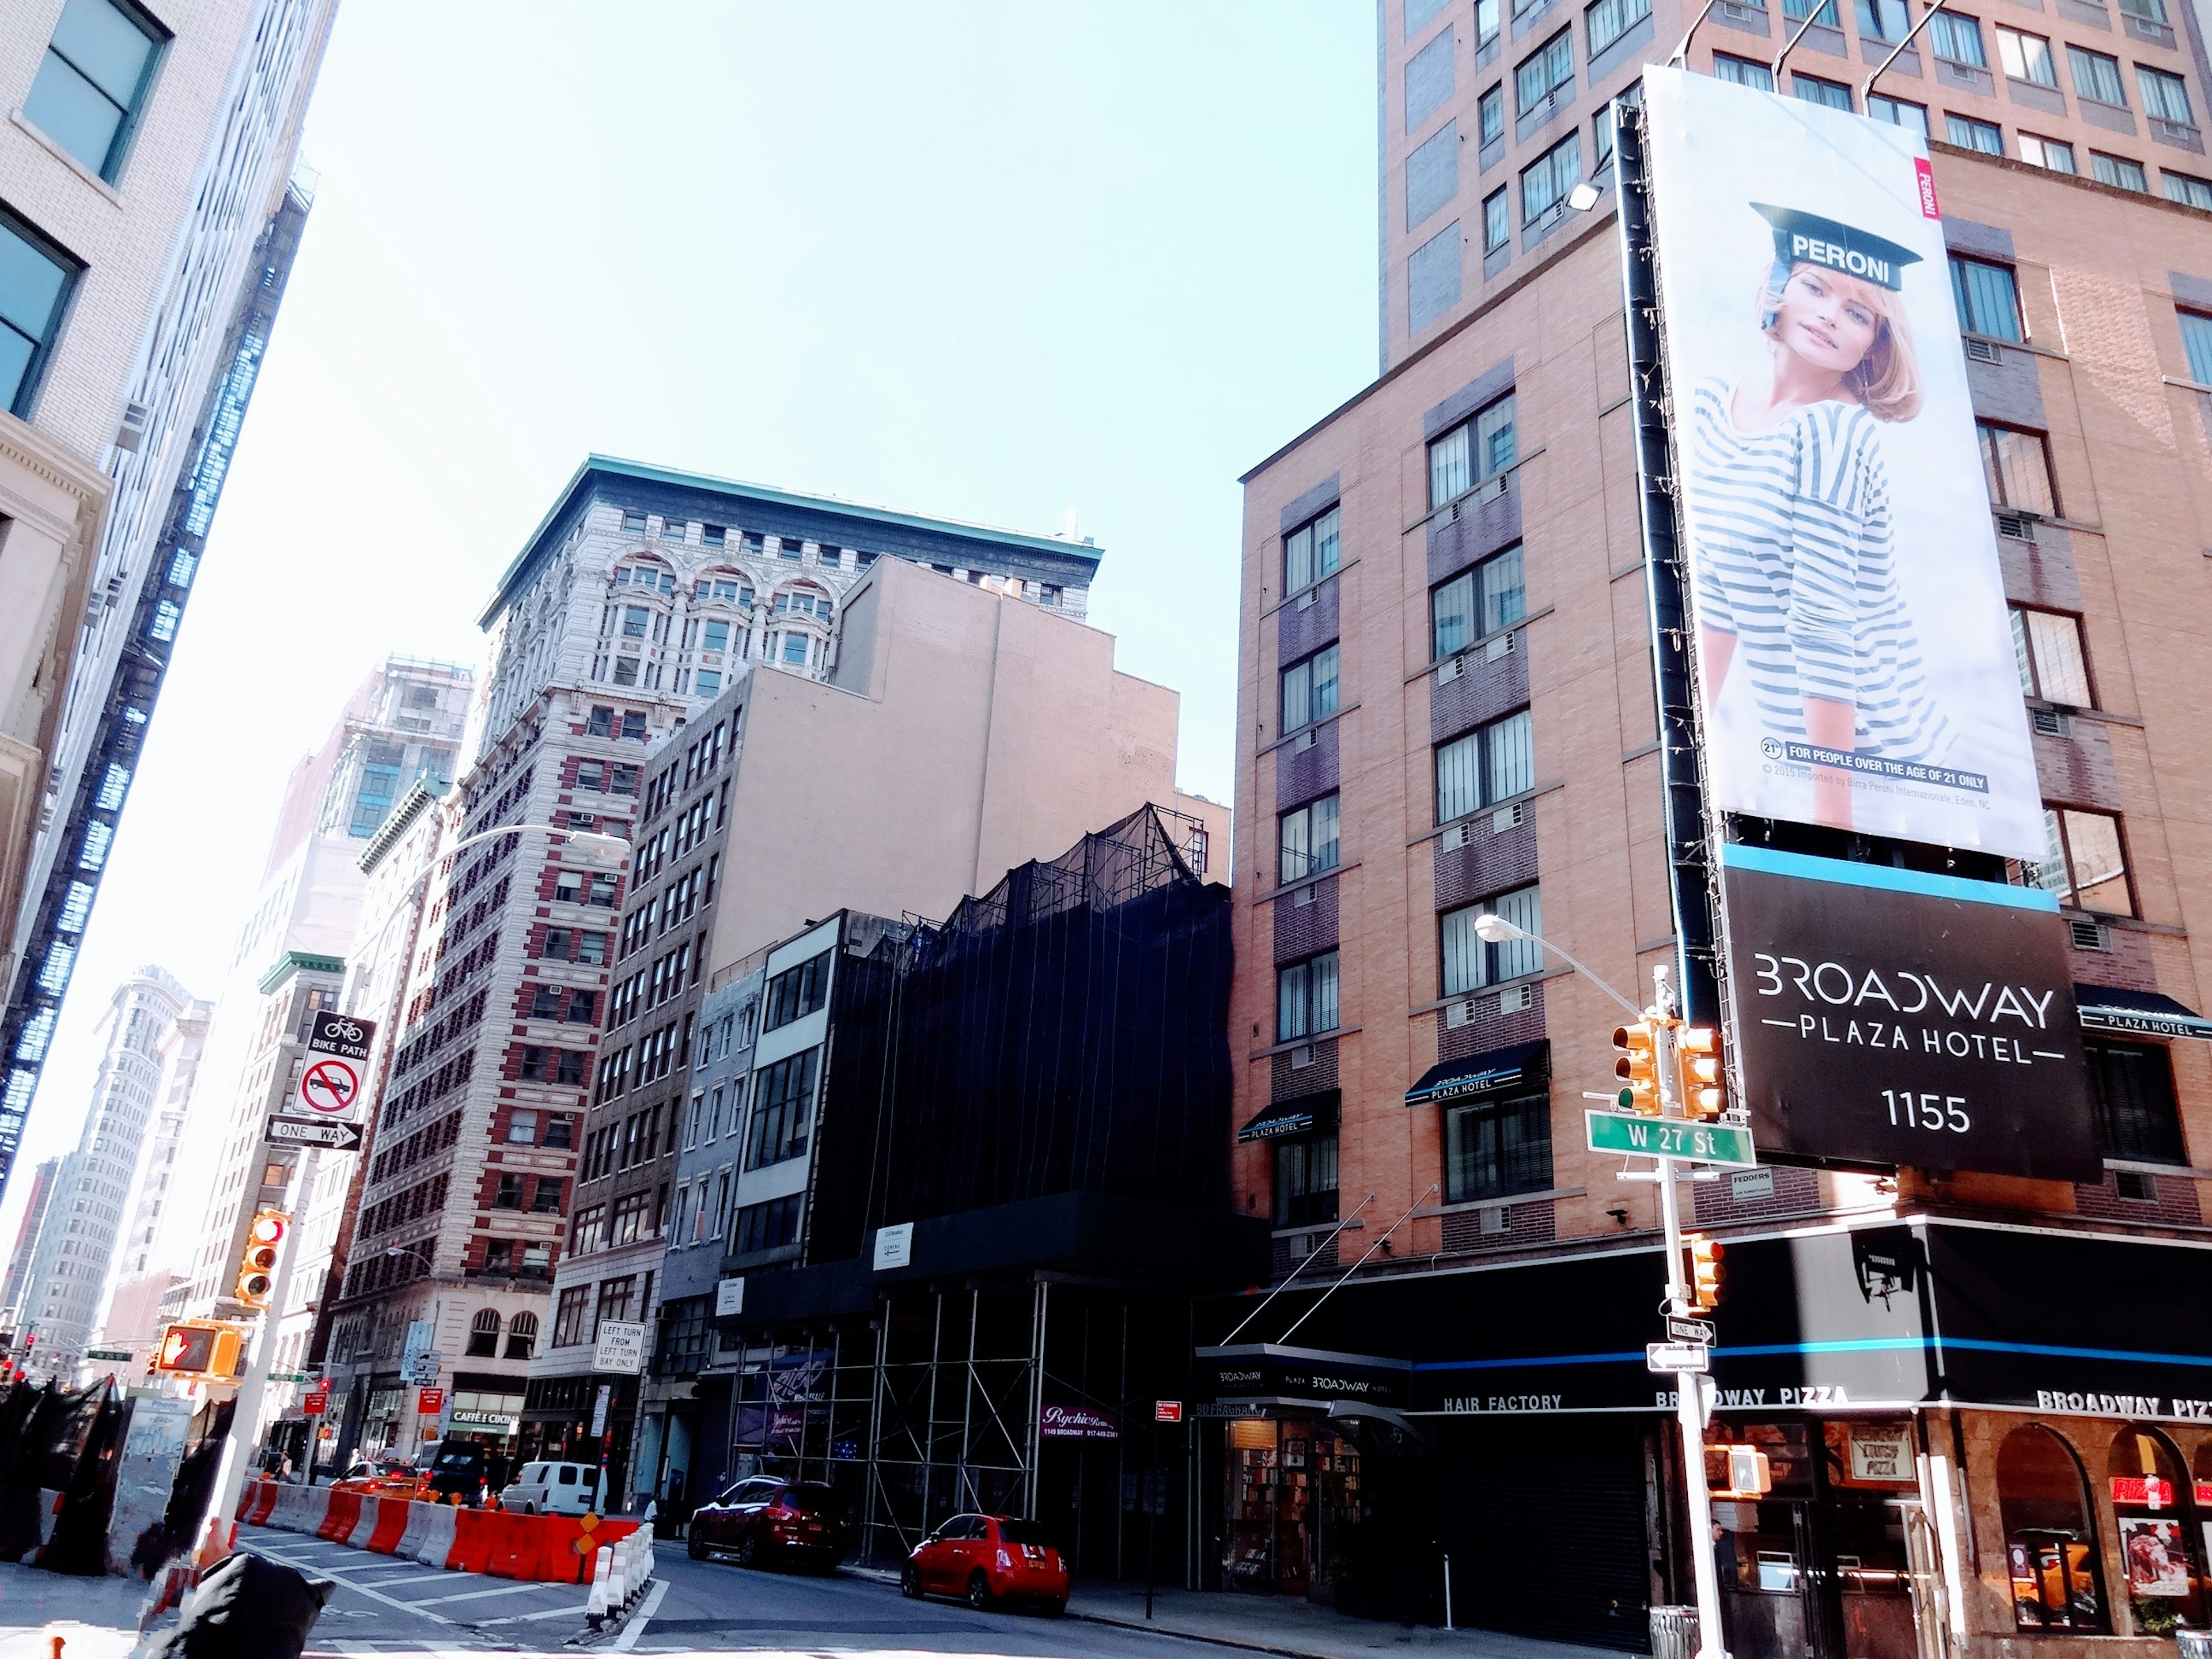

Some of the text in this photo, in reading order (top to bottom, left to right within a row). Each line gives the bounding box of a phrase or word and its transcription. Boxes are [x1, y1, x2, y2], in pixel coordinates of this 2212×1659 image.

[1919, 172, 1936, 215] PERONI
[1793, 234, 1889, 283] PERONI
[1789, 745, 1984, 789] FOR PEOPLE OVER THE AGE OF 21 ONLY
[1775, 766, 1795, 777] 2015
[1798, 770, 1834, 784] Imported
[1836, 775, 1845, 787] by
[1847, 777, 1867, 790] Birra
[1869, 781, 1893, 794] Peroni
[1956, 795, 1978, 808] Eden,
[1979, 799, 1991, 810] NC
[1755, 953, 2054, 1029] BROADWAY
[2108, 1016, 2194, 1035] PLAZA HOTEL
[312, 1038, 368, 1058] BIKE PATH
[1800, 1014, 2032, 1064] PLAZA HOTEL
[1431, 1080, 1491, 1099] PLAZA HOTEL
[1881, 1089, 1971, 1133] 1155
[280, 1124, 349, 1142] ONE WAY
[1251, 1123, 1297, 1138] PLAZA HOTEL
[1627, 1124, 1717, 1155] W 27 St
[1734, 1173, 1770, 1183] FEDDERS
[604, 1327, 641, 1337] LEFT TURN
[1675, 1324, 1709, 1339] ONE WAY
[611, 1337, 630, 1346] FROM
[600, 1347, 638, 1357] LEFT TURN
[600, 1357, 634, 1368] BAY ONLY
[1219, 1371, 1260, 1381] BROADWAY
[1286, 1376, 1305, 1384] PLAZA
[1312, 1377, 1369, 1392] BROADWAY
[151, 1400, 179, 1409] Phone
[1444, 1395, 1562, 1411] HAIR FACTORY
[1656, 1385, 1849, 1407] BRDWAY PIZZA
[2037, 1390, 2212, 1419] BROADWAY PIZ
[453, 1411, 520, 1425] CAFFÈ E CUCINA
[1043, 1407, 1090, 1427] Psychic
[1197, 1403, 1209, 1415] BD
